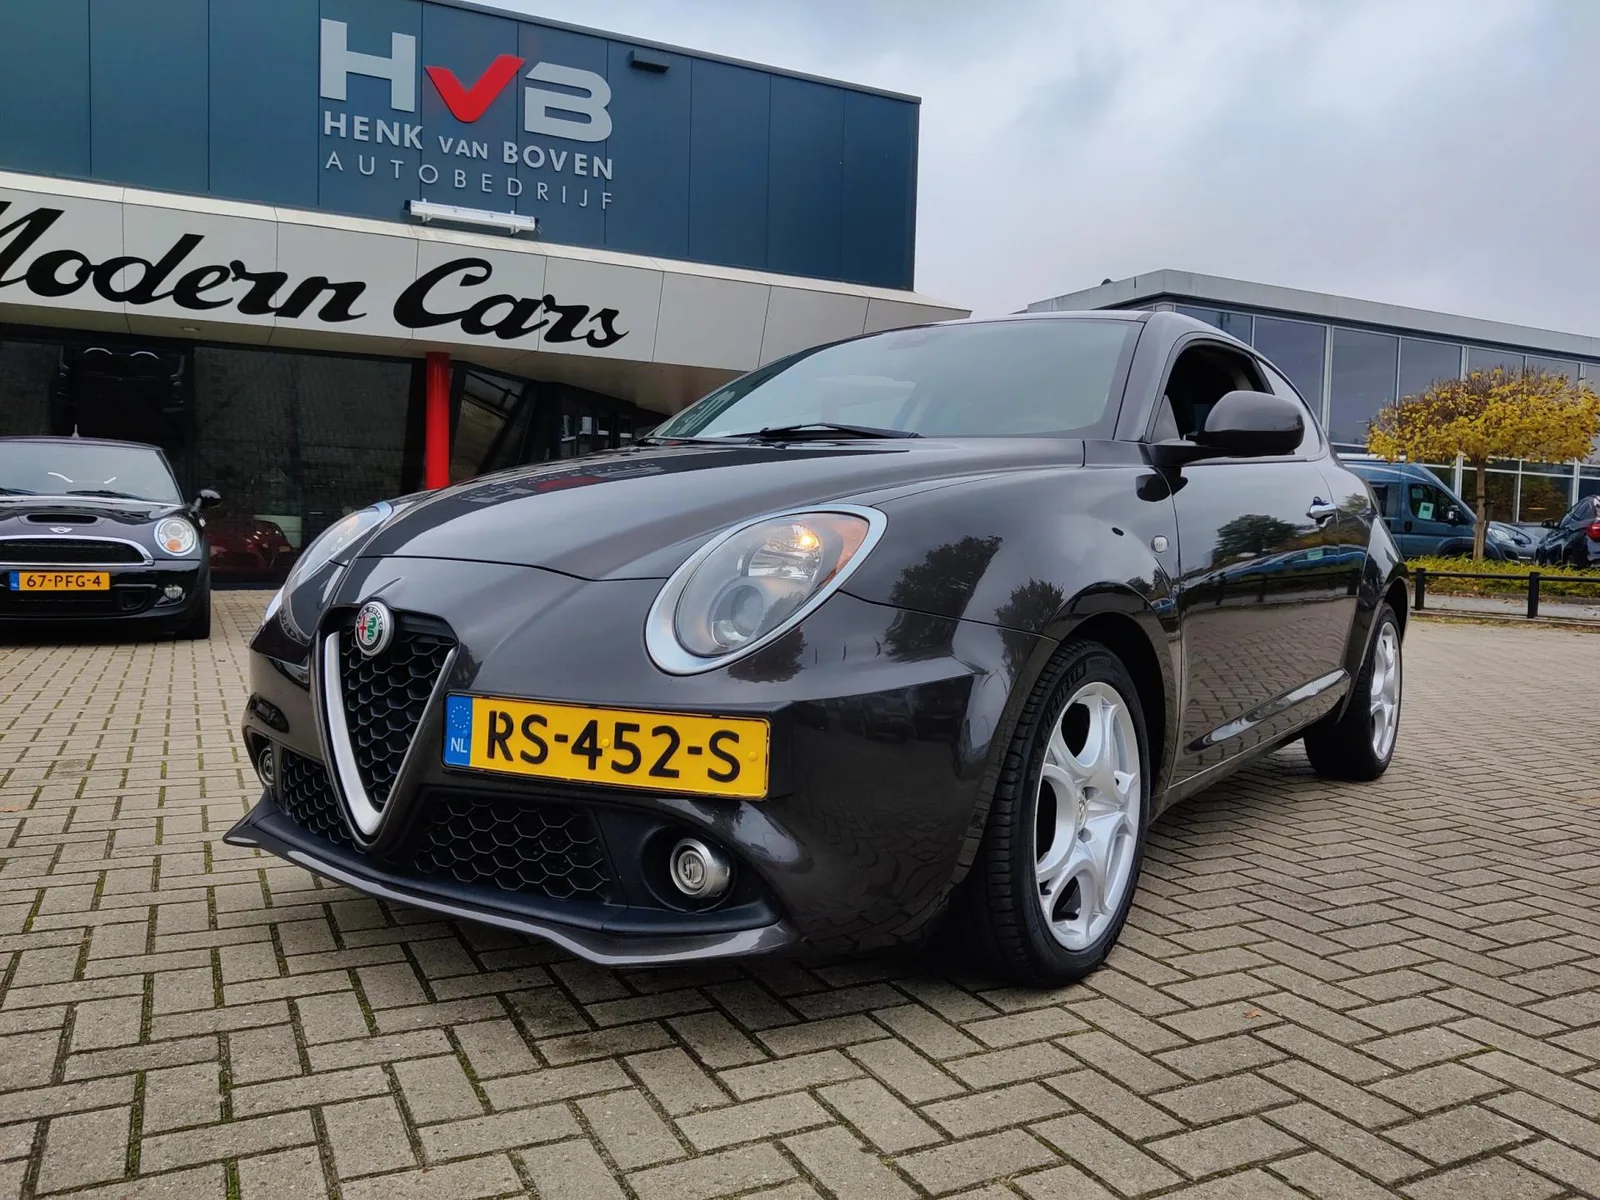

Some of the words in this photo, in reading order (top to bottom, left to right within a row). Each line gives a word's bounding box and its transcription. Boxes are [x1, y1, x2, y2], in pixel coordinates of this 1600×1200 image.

[323, 110, 424, 151] HENK
[438, 135, 488, 161] VAN
[502, 140, 613, 181] BOVEN
[324, 150, 613, 211] AUTOBEDRIJF
[393, 257, 630, 349] Cars
[26, 574, 102, 588] 67-PFG-4
[450, 736, 468, 754] NL
[486, 709, 741, 783] RS-452-S
